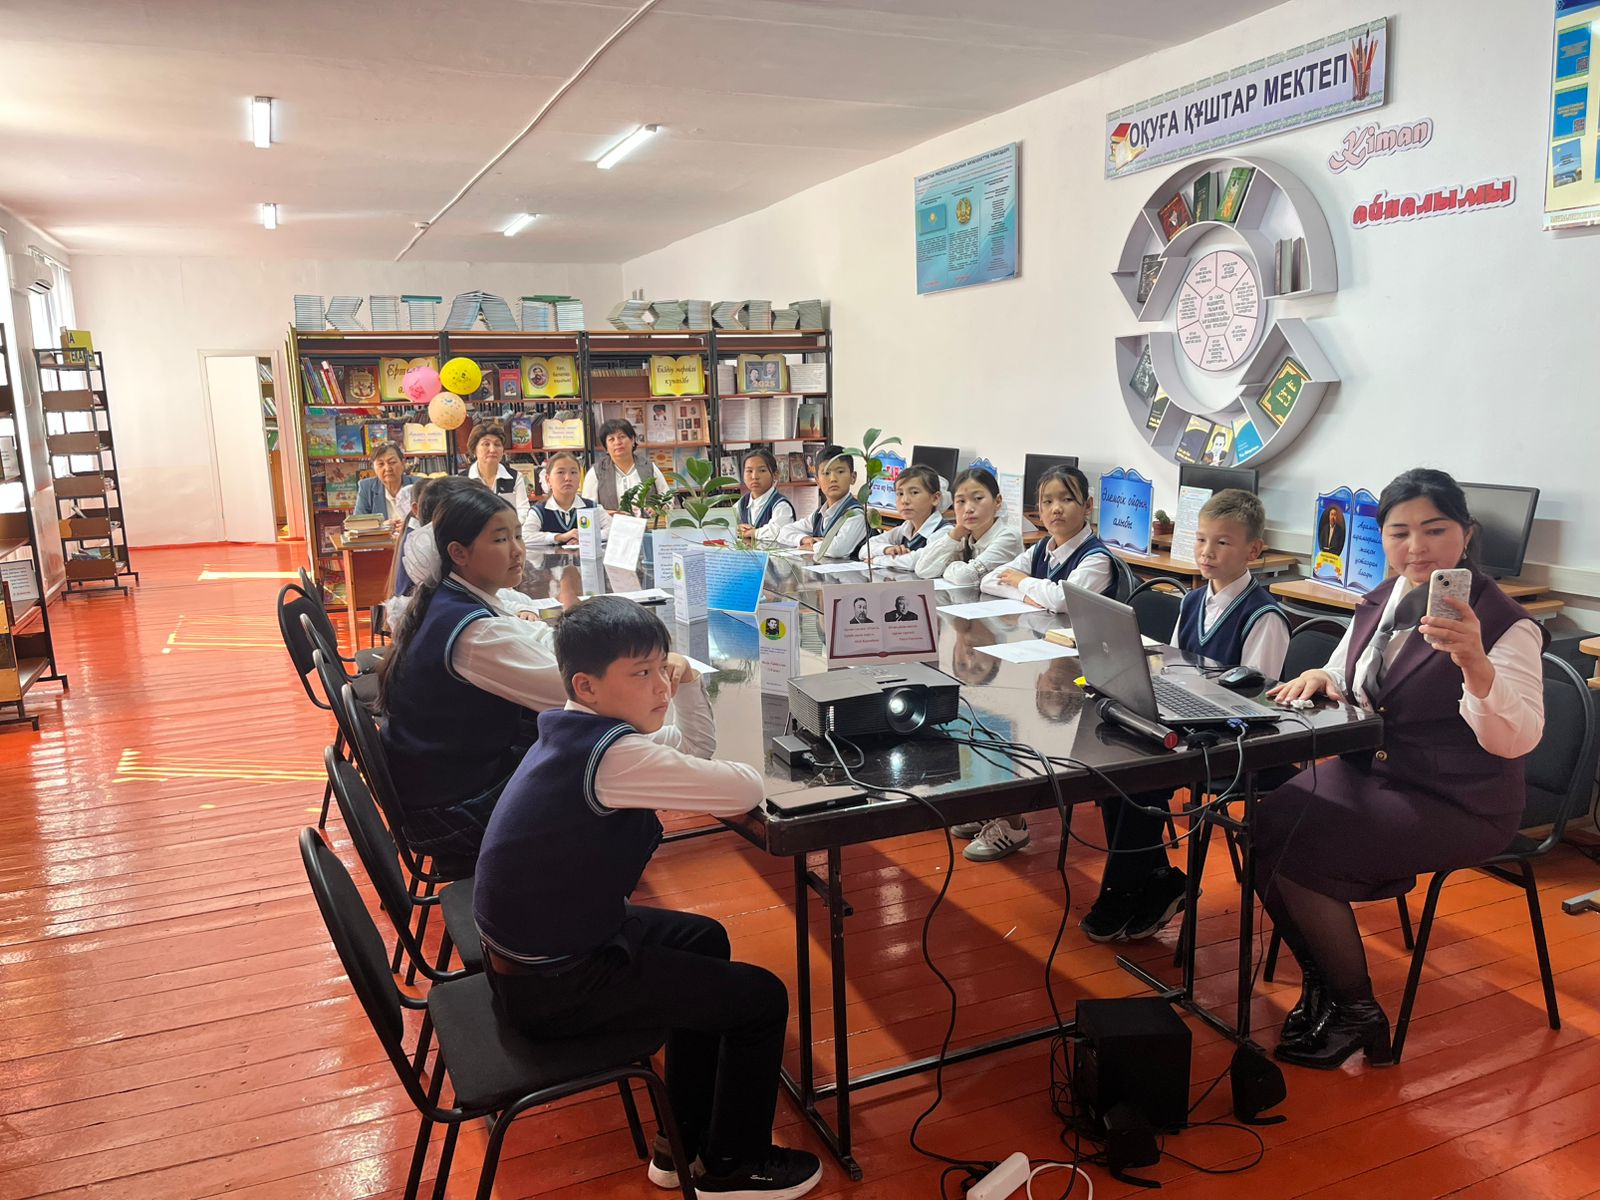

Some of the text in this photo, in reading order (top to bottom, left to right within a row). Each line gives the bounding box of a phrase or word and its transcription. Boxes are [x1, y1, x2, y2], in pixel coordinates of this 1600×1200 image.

[1129, 53, 1348, 148] ОҚУҒА ҚҰШТАР МЕКТЕП
[1352, 180, 1511, 225] айналымы
